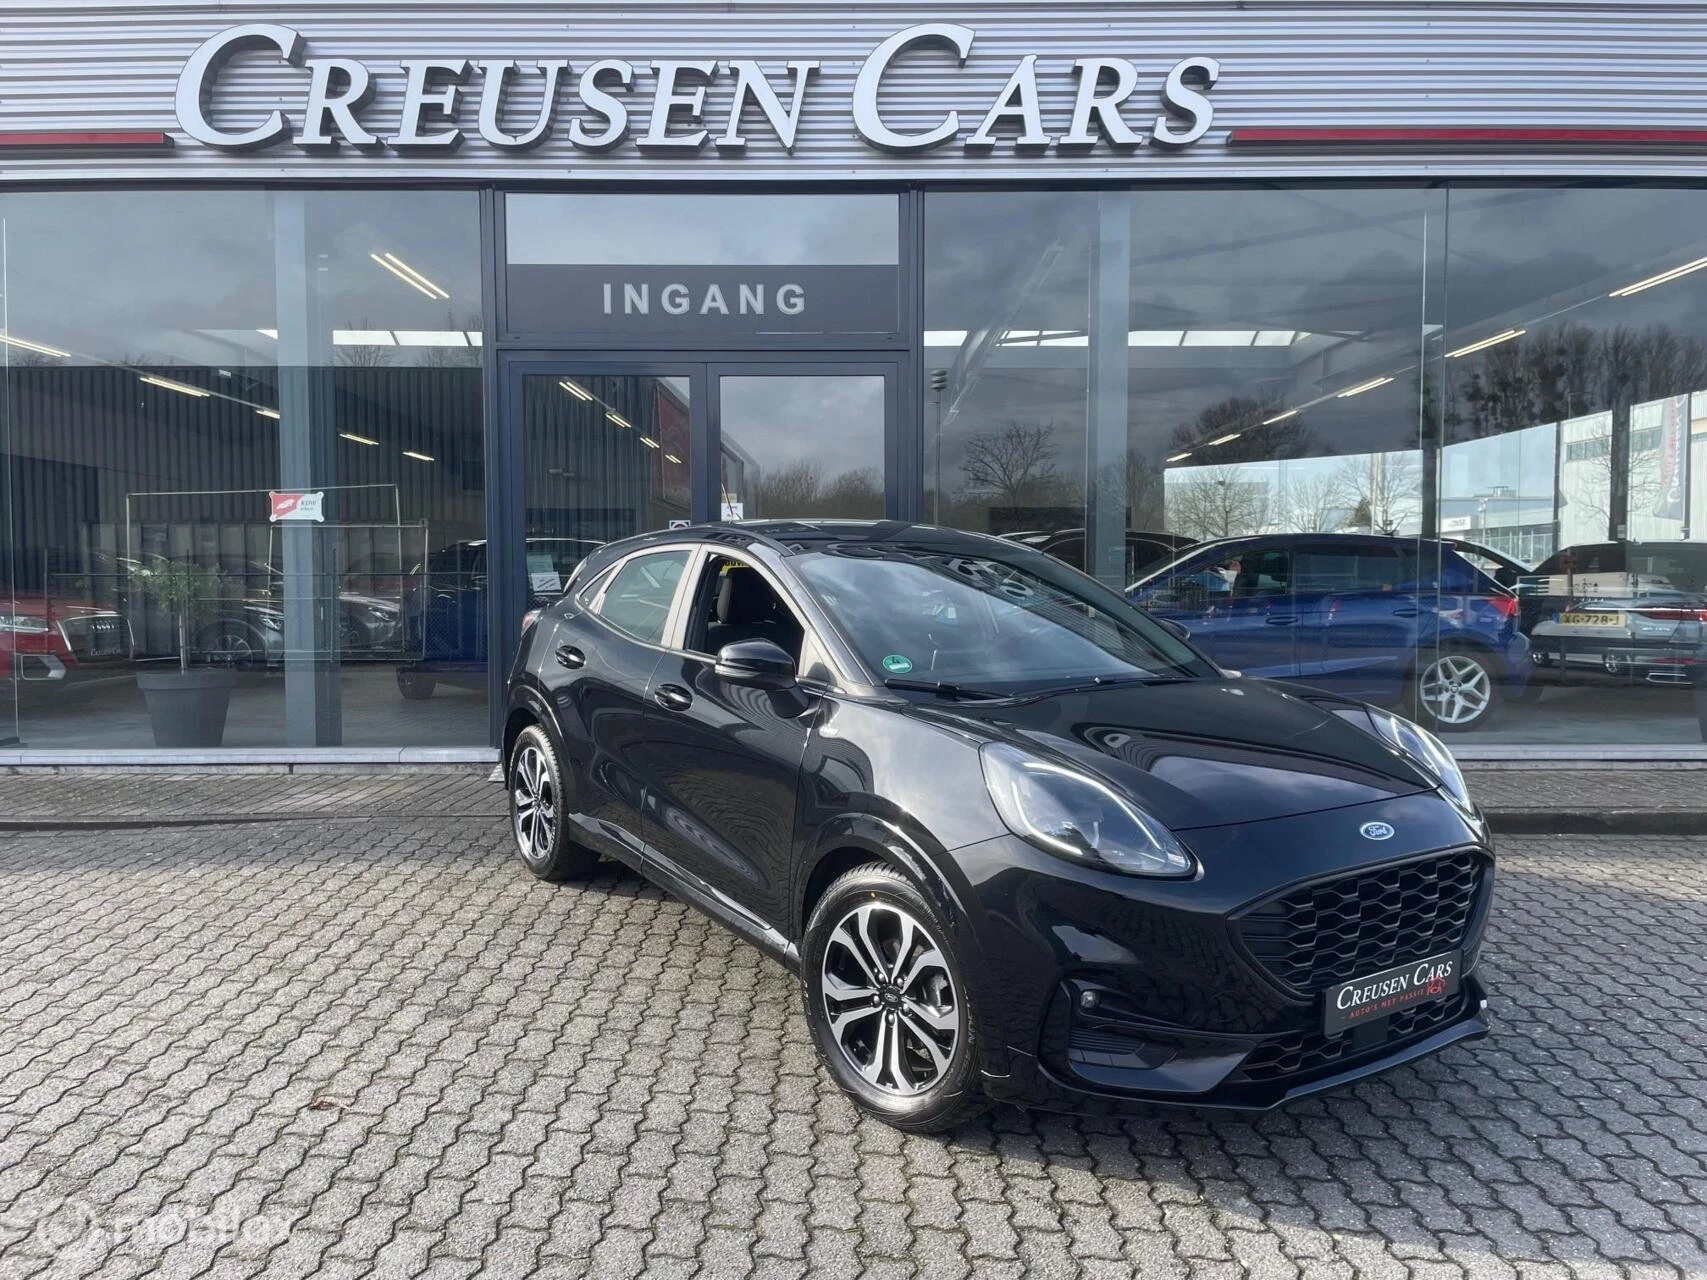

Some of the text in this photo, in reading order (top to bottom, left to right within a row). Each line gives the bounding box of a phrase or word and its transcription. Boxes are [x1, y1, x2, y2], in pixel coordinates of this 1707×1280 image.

[175, 22, 1221, 154] CREUSEN CARS
[603, 283, 805, 315] INGANG
[1336, 960, 1453, 1010] CREUSEN CARS
[1380, 998, 1397, 1010] MET
